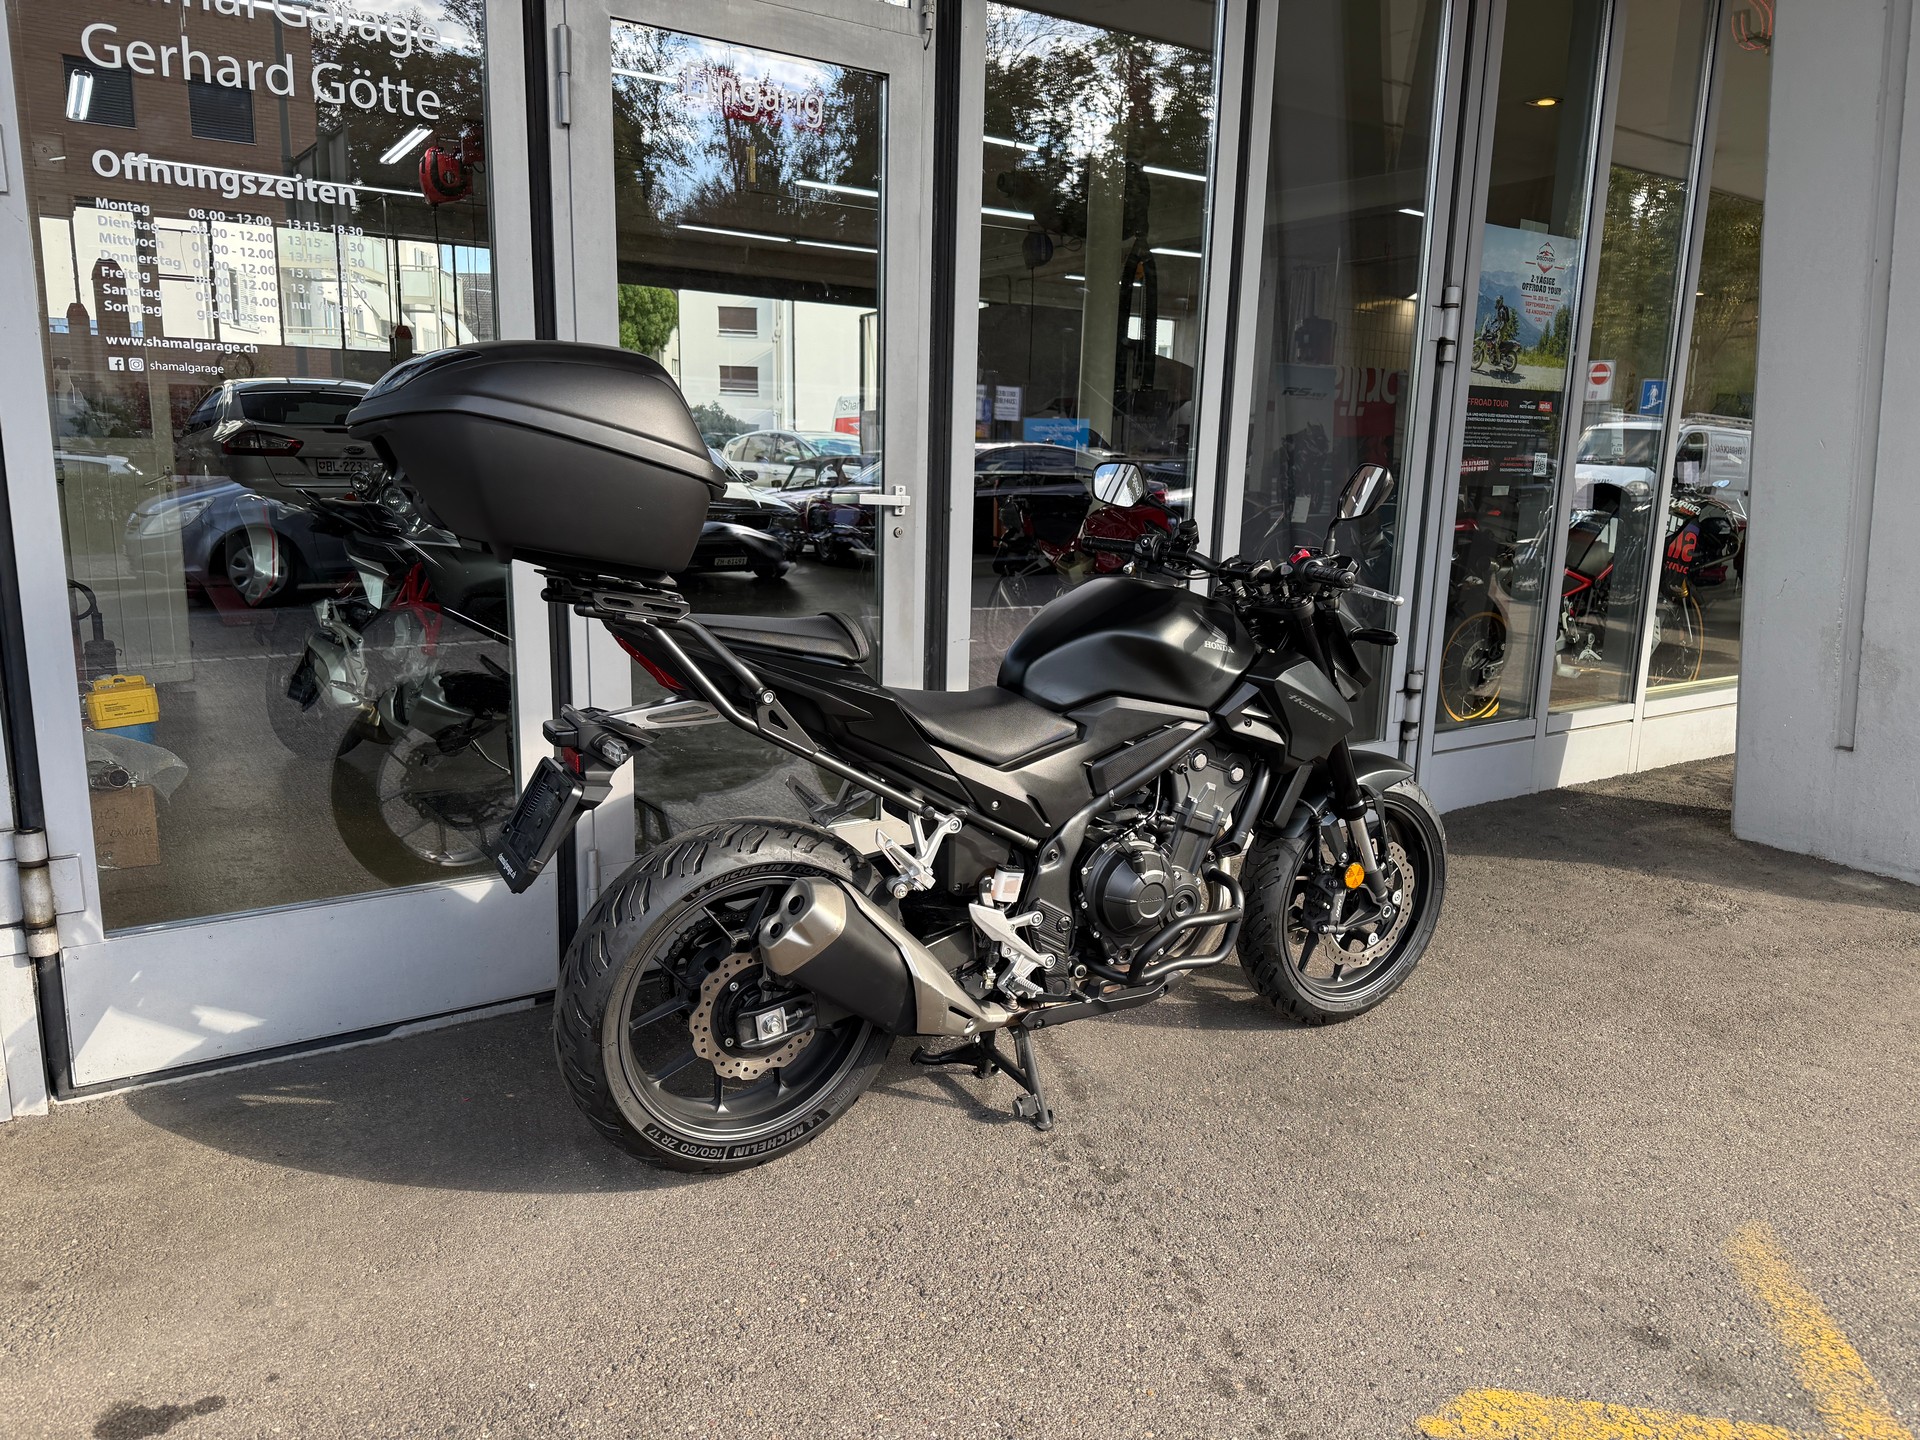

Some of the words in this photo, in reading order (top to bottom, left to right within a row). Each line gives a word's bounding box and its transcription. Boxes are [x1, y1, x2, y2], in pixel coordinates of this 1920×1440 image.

[272, 0, 441, 58] Garage
[81, 22, 295, 97] Gerhard
[311, 62, 441, 120] Götte
[686, 61, 825, 128] Eingang
[95, 197, 150, 216] Montag
[189, 208, 225, 221] 08.00
[237, 213, 272, 227] 12.00
[287, 219, 320, 232] 13.15
[330, 224, 363, 237] 18.30
[97, 215, 159, 234] Dienstag
[239, 230, 273, 244] 12.00
[99, 232, 164, 249] Mittwoch
[240, 247, 274, 260] 12.00
[332, 257, 365, 268] .30
[100, 249, 182, 271] Donnerstag
[241, 263, 275, 276] 12.00
[333, 270, 366, 283] 8.30
[101, 266, 151, 283] Freitag
[243, 279, 276, 292] 12.00
[290, 283, 324, 296] 13.5
[102, 283, 162, 300] Samstag
[244, 296, 278, 308] 14.00
[291, 301, 312, 310] nur
[104, 300, 162, 317] Sonntag
[196, 308, 275, 323] geschlossen
[106, 336, 259, 354] www.shamalgarage.ch
[150, 360, 225, 375] shamalgarage
[1493, 399, 1509, 408] TOUR
[1204, 640, 1235, 653] HONDA
[710, 863, 787, 888] MICHELIN
[646, 1127, 662, 1143] 17
[661, 1134, 680, 1151] ZR
[732, 1123, 805, 1158] MICHELIN
[680, 1142, 724, 1159] 160/60
